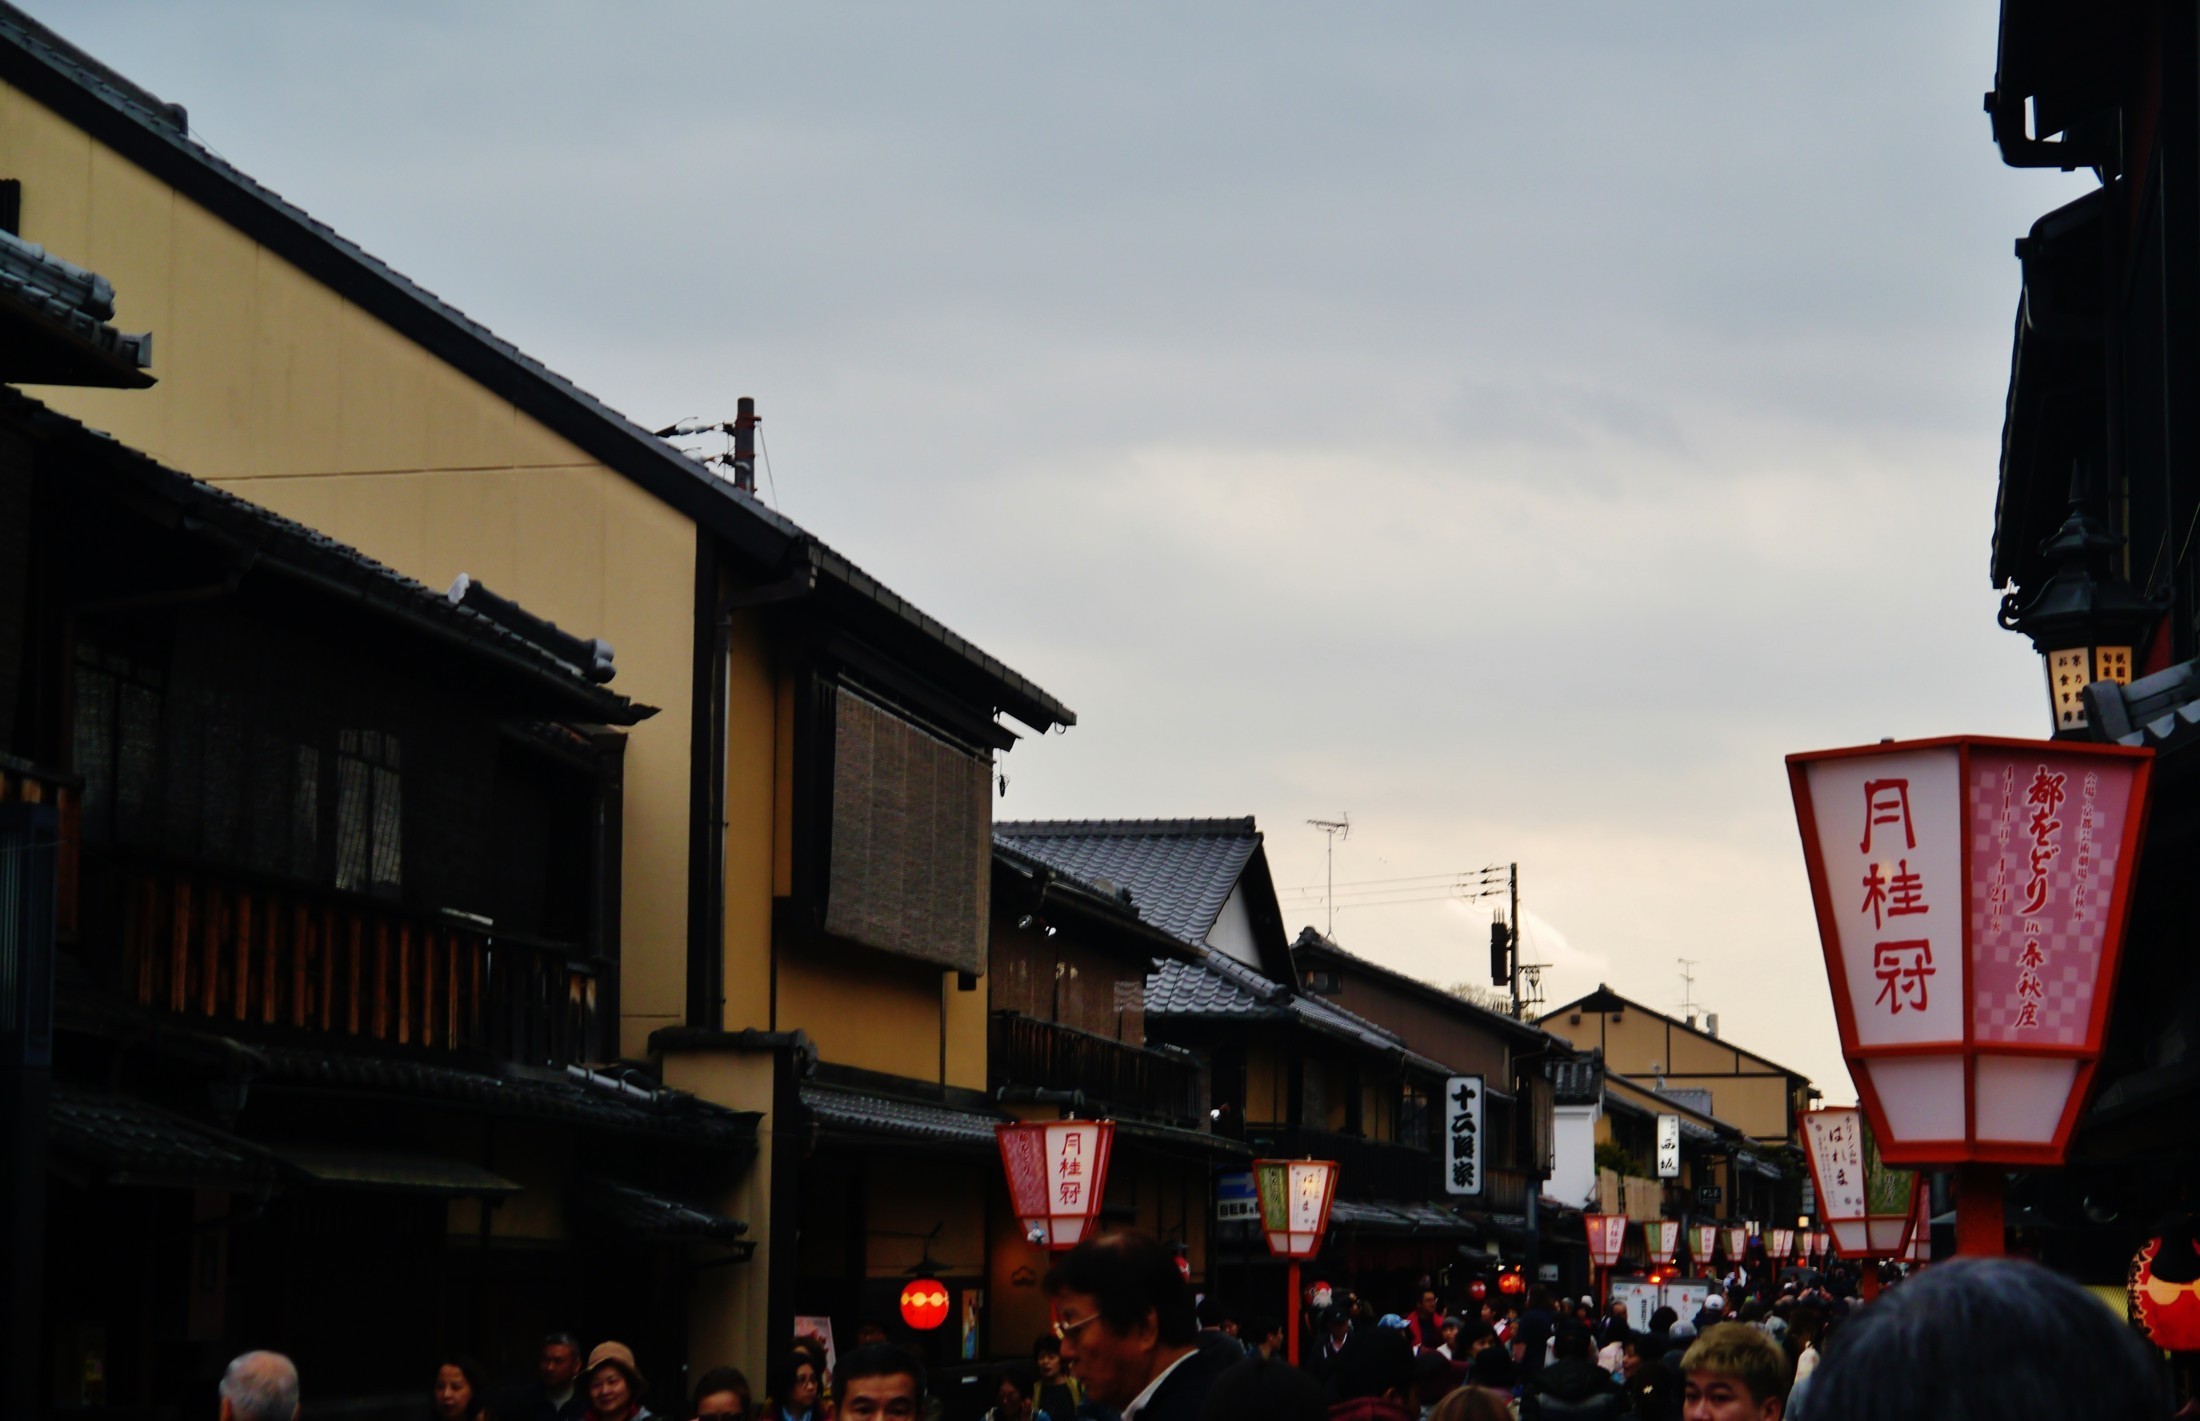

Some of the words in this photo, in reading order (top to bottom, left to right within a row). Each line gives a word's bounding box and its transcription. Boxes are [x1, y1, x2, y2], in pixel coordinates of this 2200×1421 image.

[2019, 764, 2067, 915] 都をどり
[1860, 778, 1936, 1014] 月桂冠
[2025, 922, 2040, 933] in
[2014, 937, 2045, 1029] 春秋座
[1059, 1132, 1081, 1205] 月桂冠
